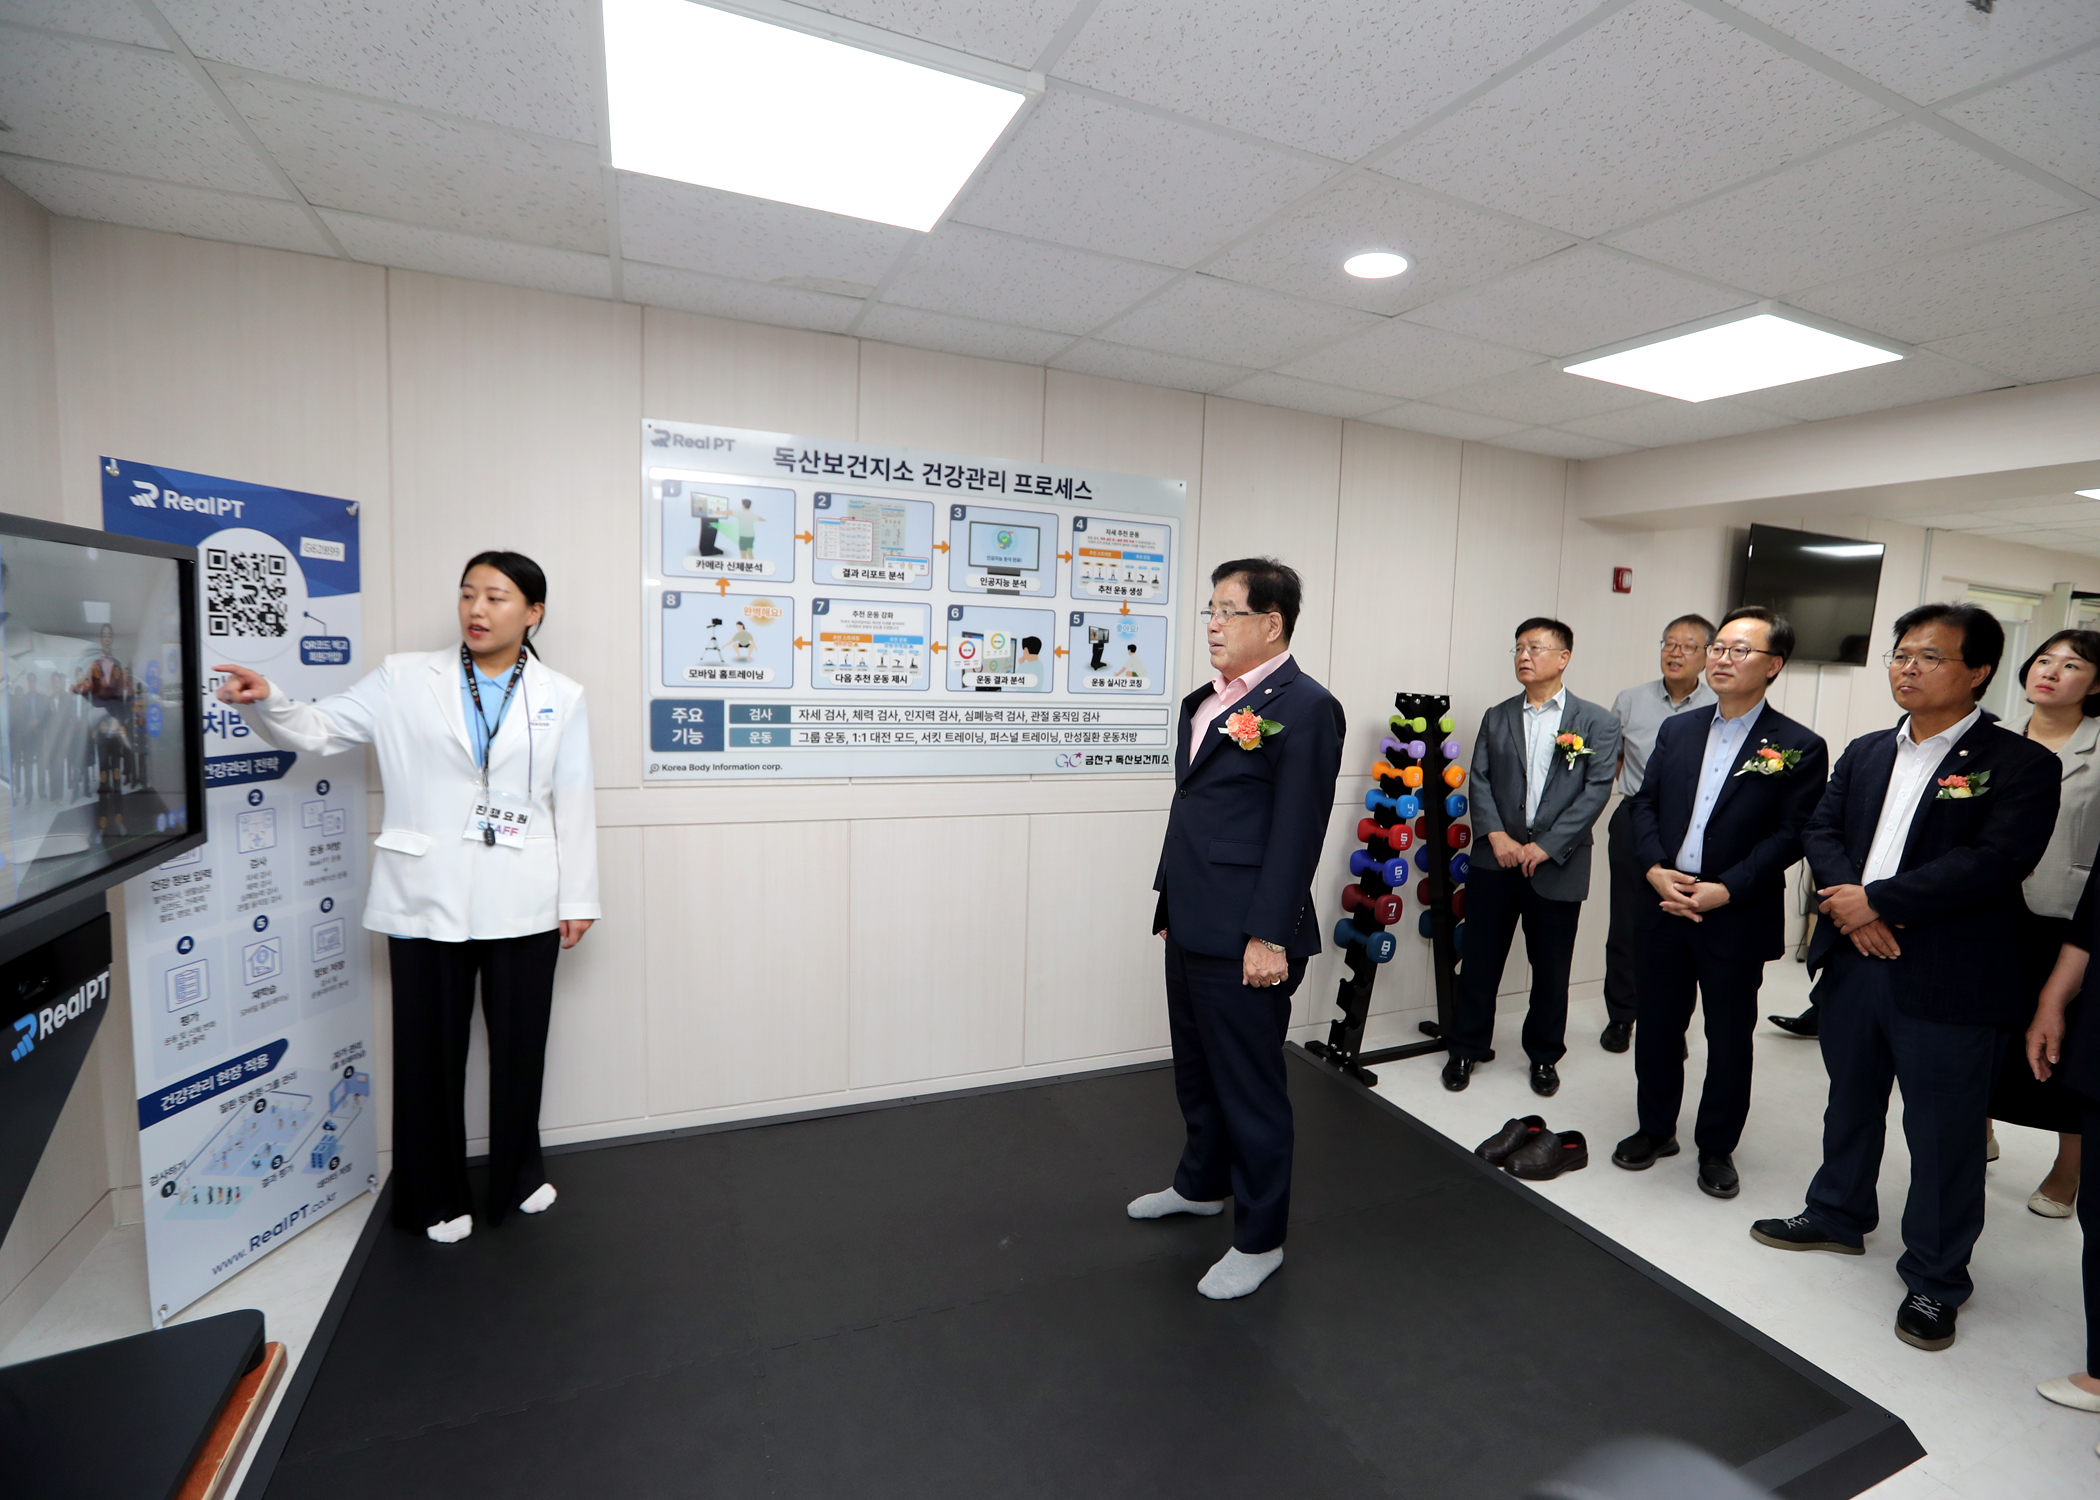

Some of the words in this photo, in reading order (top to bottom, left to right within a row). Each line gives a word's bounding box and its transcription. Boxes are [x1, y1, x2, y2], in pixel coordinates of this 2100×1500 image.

[673, 433, 710, 450] Real
[714, 438, 735, 451] PT
[773, 447, 914, 482] 독산보건지소
[922, 462, 1006, 493] 건강관리
[1014, 473, 1092, 500] 프로세스
[163, 490, 245, 518] RealPT
[818, 495, 826, 506] 2
[954, 508, 962, 518] 3
[1076, 520, 1084, 530] 4
[696, 560, 723, 571] 카메라
[726, 560, 762, 572] 신체분석
[842, 568, 859, 578] 결과
[862, 569, 886, 579] 리포트
[888, 571, 904, 580] 분석
[980, 578, 1010, 588] 인공지능
[1012, 579, 1027, 588] 분석
[1098, 586, 1112, 594] 추천
[1114, 586, 1127, 595] 운동
[1129, 587, 1142, 596] 생성
[666, 594, 676, 606] 8
[744, 606, 782, 617] 완벽해요!
[816, 601, 824, 612] 7
[852, 610, 866, 618] 추천
[952, 608, 959, 618] 6
[1074, 614, 1080, 624] 5
[1116, 624, 1138, 632] 좋아요!
[688, 669, 716, 679] 모바일
[719, 670, 764, 680] 홈트레이닝
[836, 674, 852, 683] 다음
[854, 674, 870, 684] 추천
[873, 675, 889, 684] 운동
[892, 675, 908, 684] 제시
[976, 676, 991, 684] 운동
[994, 676, 1008, 684] 결과
[1010, 676, 1024, 684] 분석
[1092, 679, 1106, 687] 운동
[1107, 679, 1128, 687] 실시간
[1129, 680, 1142, 688] 코칭
[672, 708, 704, 724] 주요
[749, 708, 772, 721] 검사
[798, 708, 820, 722] 자세
[824, 709, 850, 722] 검사,
[852, 709, 874, 722] 체력
[877, 710, 901, 722] 검사,
[904, 710, 934, 722] 인지력
[938, 710, 961, 722] 검사,
[964, 710, 1004, 722] 심폐능력
[1006, 711, 1028, 723] 검사,
[1031, 711, 1050, 722] 관절
[1052, 711, 1080, 722] 움직임
[1082, 711, 1100, 722] 검사
[672, 729, 704, 745] 기능
[749, 731, 772, 744] 운동
[798, 732, 820, 744] 그룹
[824, 732, 849, 745] 운동,
[852, 732, 867, 743] 1:1
[870, 732, 891, 744] 대전
[894, 732, 918, 745] 모드,
[921, 732, 941, 743] 서킷
[945, 732, 986, 744] 트레이닝,
[990, 732, 1018, 743] 퍼스널
[1022, 732, 1061, 744] 트레이닝,
[1064, 732, 1100, 743] 만성질환
[1102, 732, 1138, 743] 운동처방
[254, 757, 279, 772] 전략
[1086, 755, 1113, 766] 금천구
[1116, 754, 1170, 766] 독산보건지소
[662, 764, 686, 772] Korea
[688, 764, 710, 773] Body
[762, 764, 782, 773] corp.
[1400, 833, 1408, 842] 5
[1460, 832, 1466, 840] 5
[1394, 866, 1402, 876] 6
[150, 878, 170, 891] 건강
[172, 874, 192, 886] 정보
[193, 869, 212, 881] 입력
[1388, 902, 1396, 914] 7
[1381, 940, 1391, 952] 8
[39, 971, 110, 1040] RealPT
[180, 1011, 200, 1026] 평가
[160, 1076, 214, 1111] 건강관리
[216, 1064, 243, 1086] 현장
[244, 1053, 270, 1072] 적용
[282, 1071, 298, 1085] 관리
[149, 1160, 186, 1186] 검사하기
[262, 1174, 277, 1188] 결과
